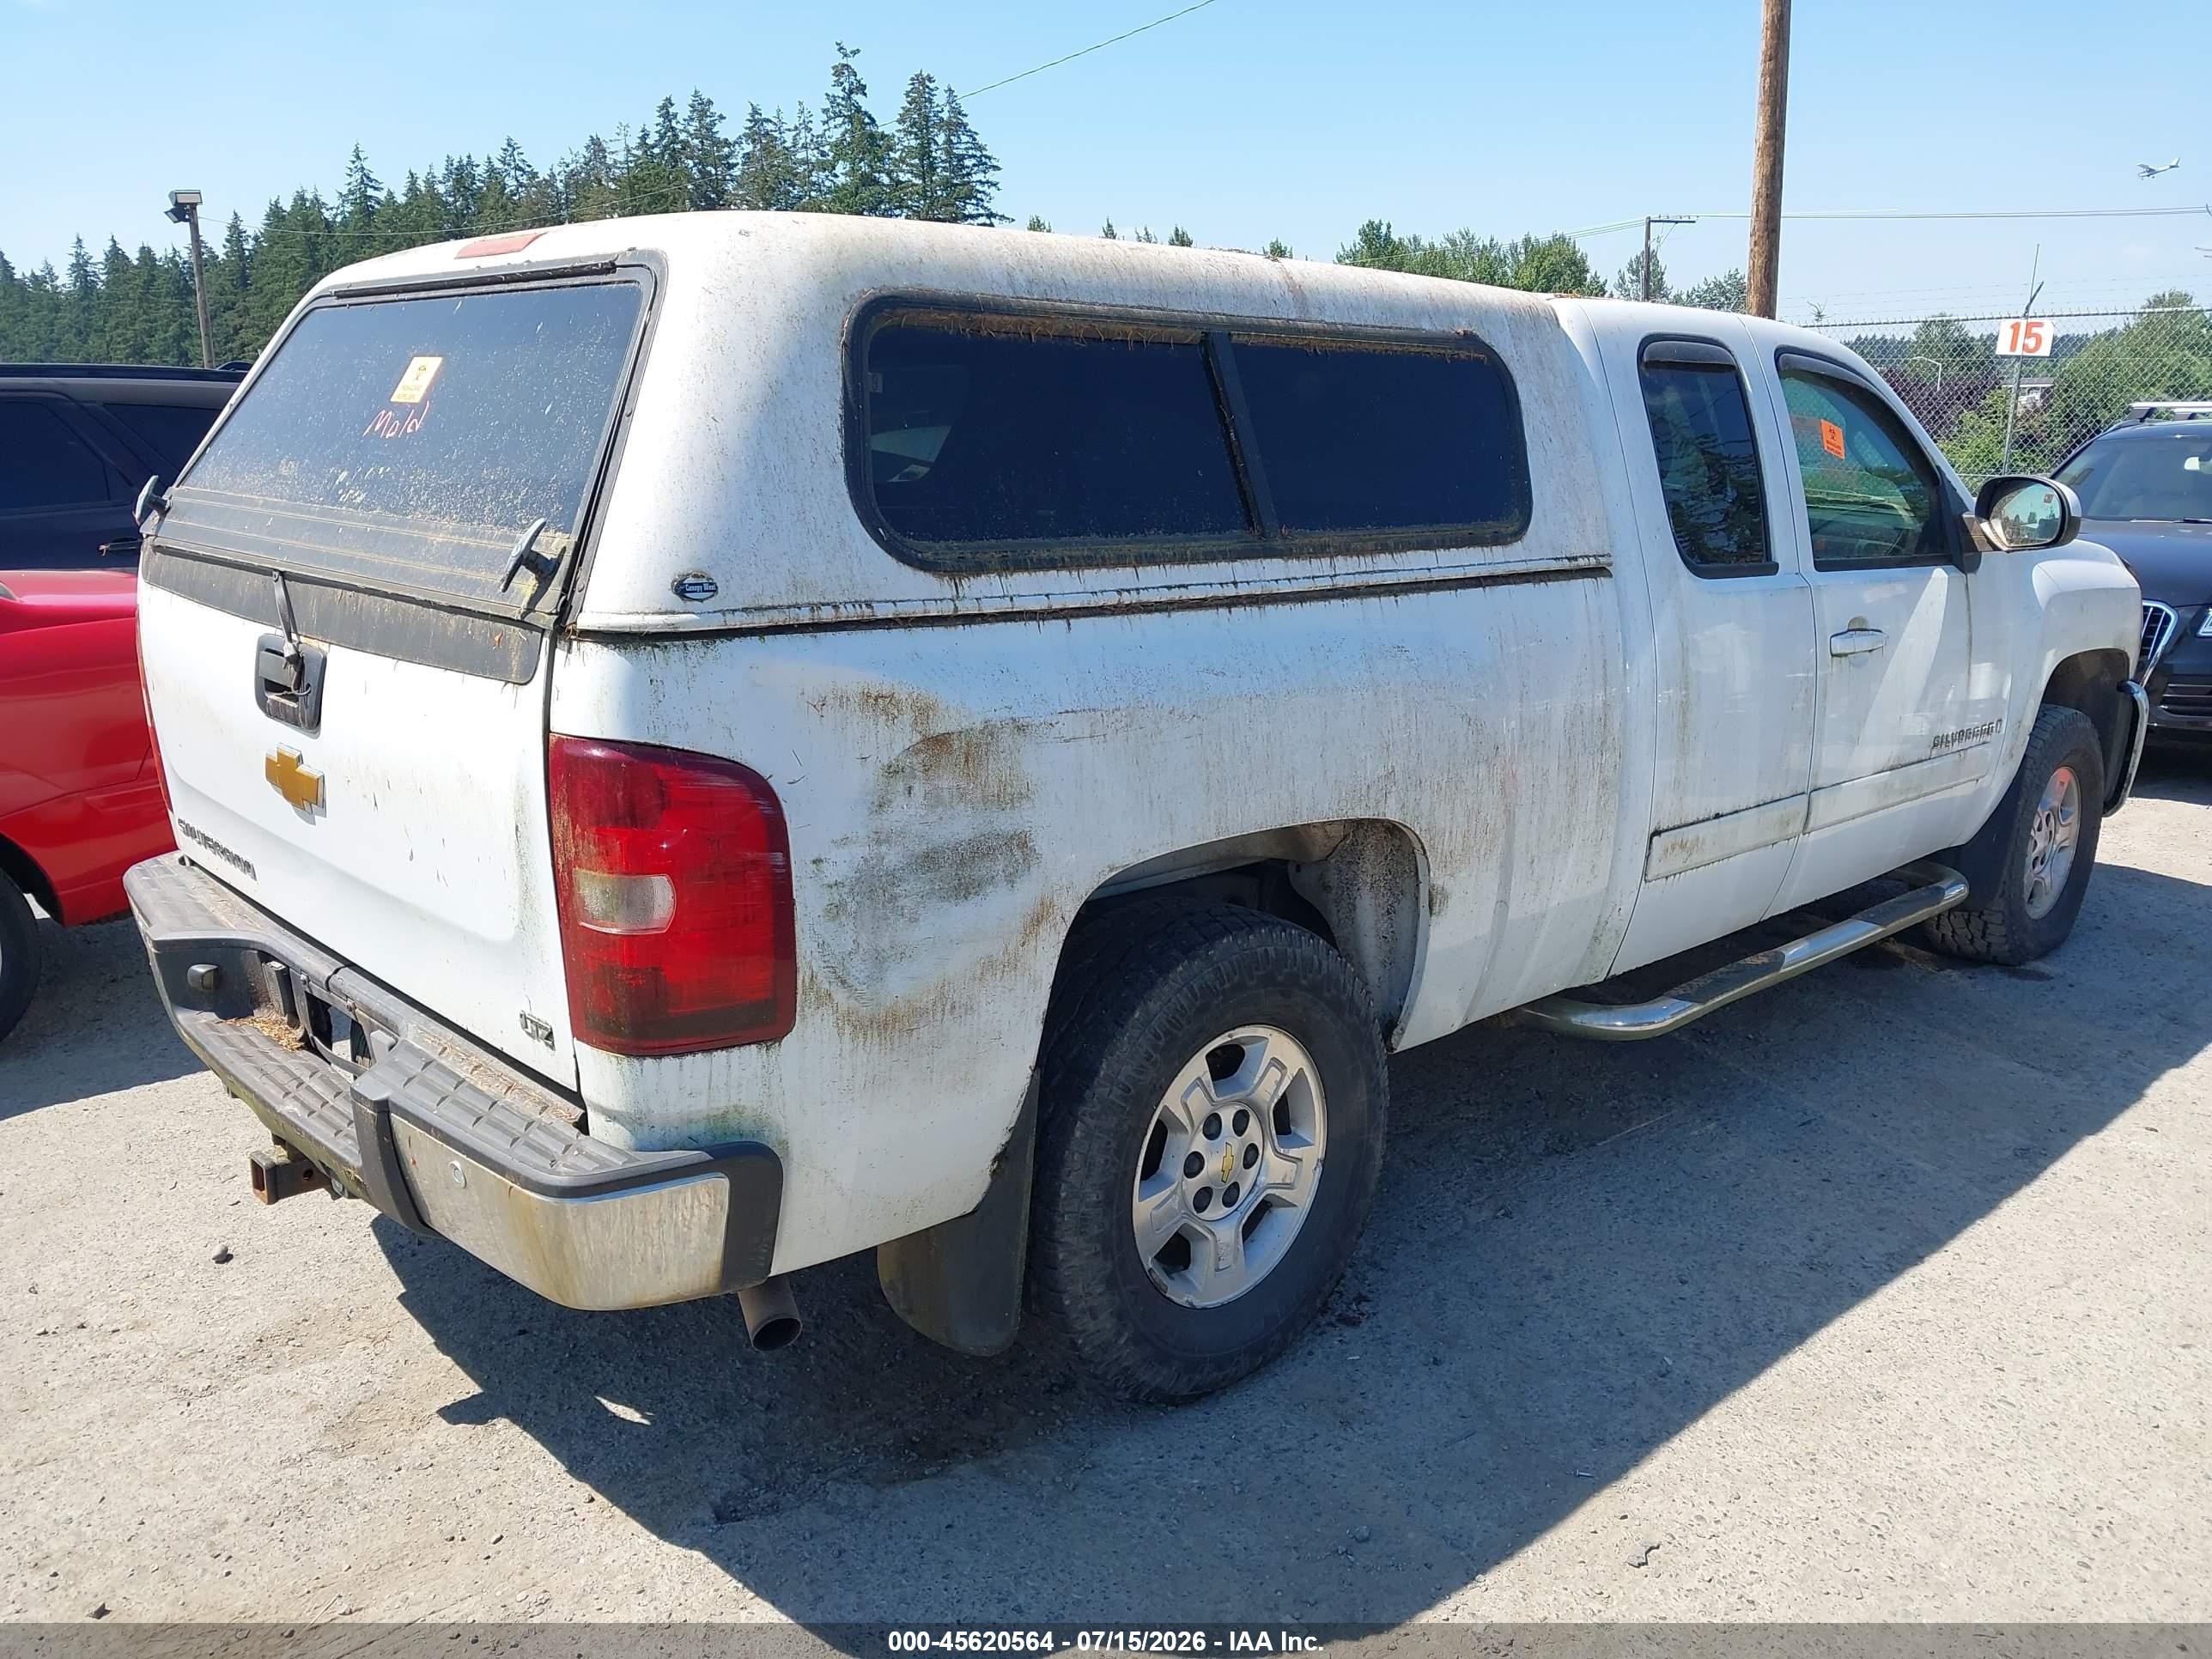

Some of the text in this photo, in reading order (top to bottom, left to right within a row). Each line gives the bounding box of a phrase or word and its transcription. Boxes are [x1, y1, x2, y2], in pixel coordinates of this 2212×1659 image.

[2009, 321, 2045, 354] 15
[363, 400, 430, 439] Mold
[1932, 719, 2002, 750] SILVERADO
[520, 1010, 556, 1052] LTZ
